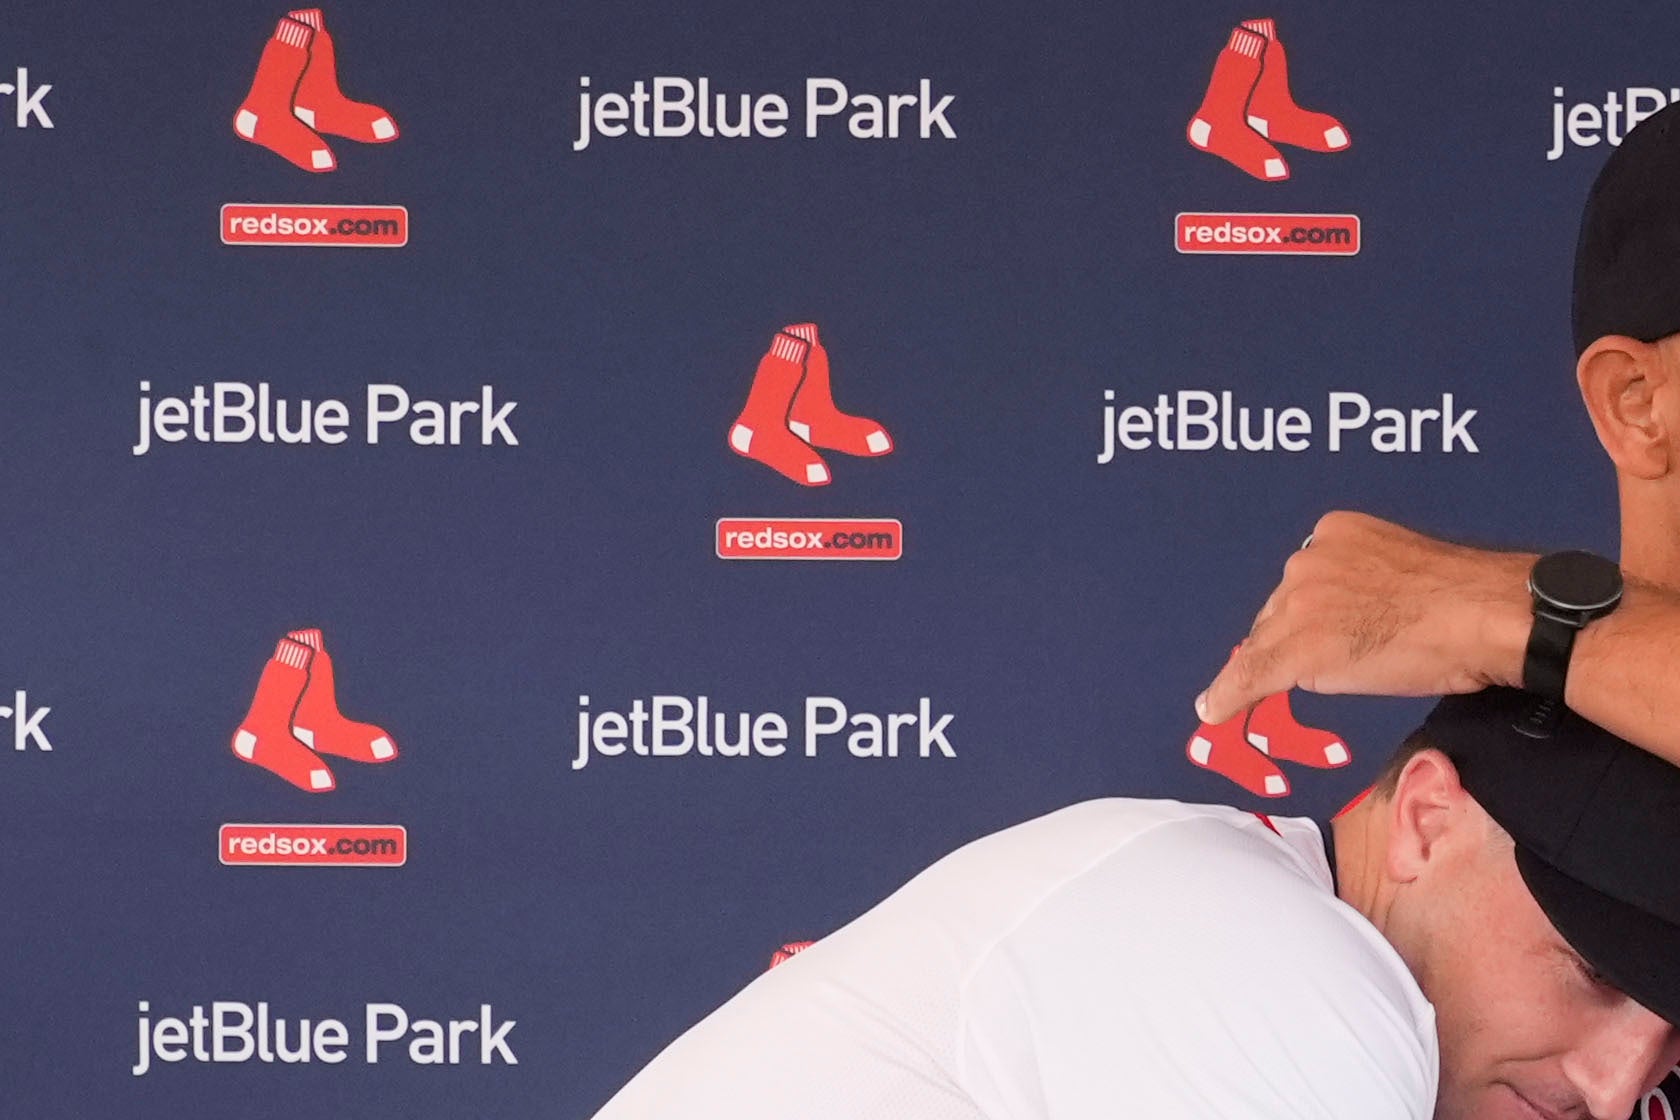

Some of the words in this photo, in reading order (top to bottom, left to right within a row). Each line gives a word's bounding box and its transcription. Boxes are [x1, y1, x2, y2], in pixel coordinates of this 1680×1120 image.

[574, 77, 788, 150] jetBlue
[807, 78, 956, 138] Park
[1547, 87, 1680, 160] jetB
[231, 213, 399, 236] redsox.com
[1185, 222, 1351, 244] redsox.com
[133, 381, 349, 455] jetBlue
[367, 384, 518, 445] Park
[1098, 390, 1311, 464] jetBlue
[1329, 392, 1479, 452] Park
[726, 527, 893, 549] redsox.com
[572, 695, 788, 769] jetBlue
[806, 697, 956, 757] Park
[229, 833, 397, 855] redsox.com
[133, 1001, 348, 1075] jetBlue
[367, 1004, 518, 1064] Park
